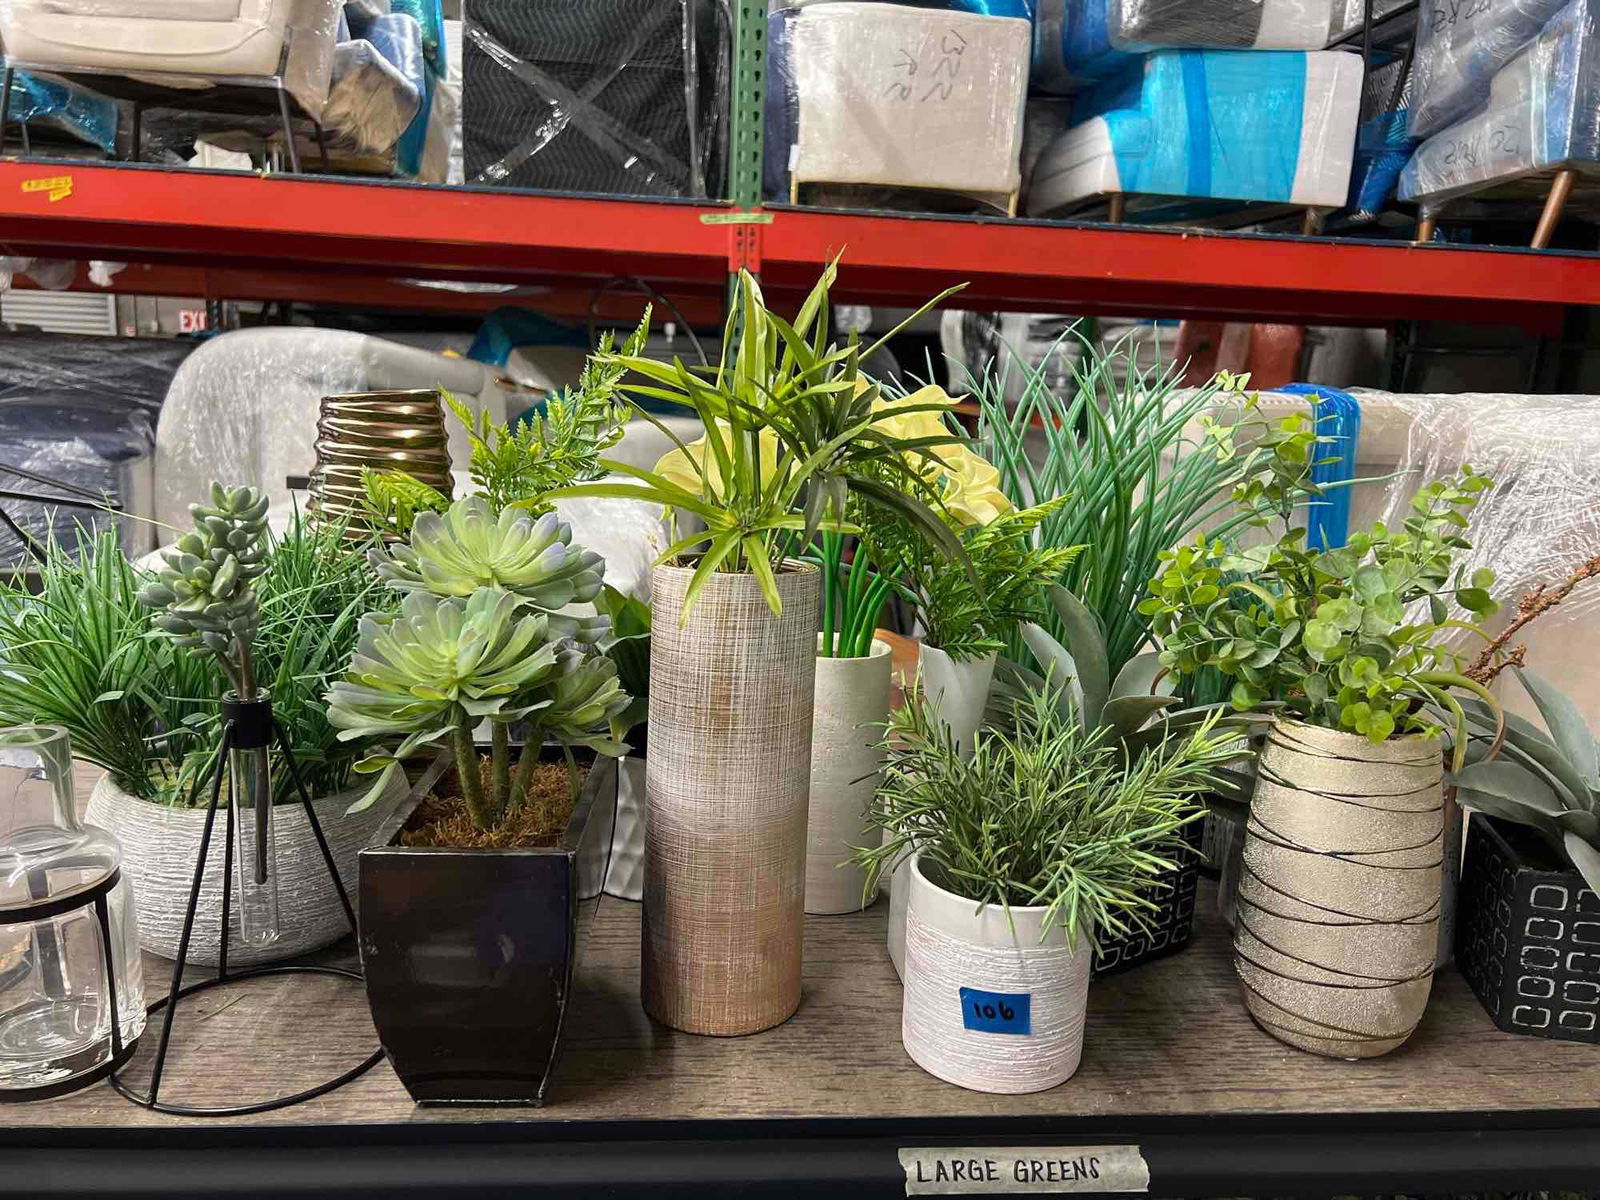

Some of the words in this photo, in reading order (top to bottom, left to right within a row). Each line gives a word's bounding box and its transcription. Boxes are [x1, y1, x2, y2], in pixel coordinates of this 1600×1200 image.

[974, 1000, 1015, 1020] 106
[917, 1159, 1000, 1183] LARGE
[1013, 1156, 1101, 1182] GREENS
